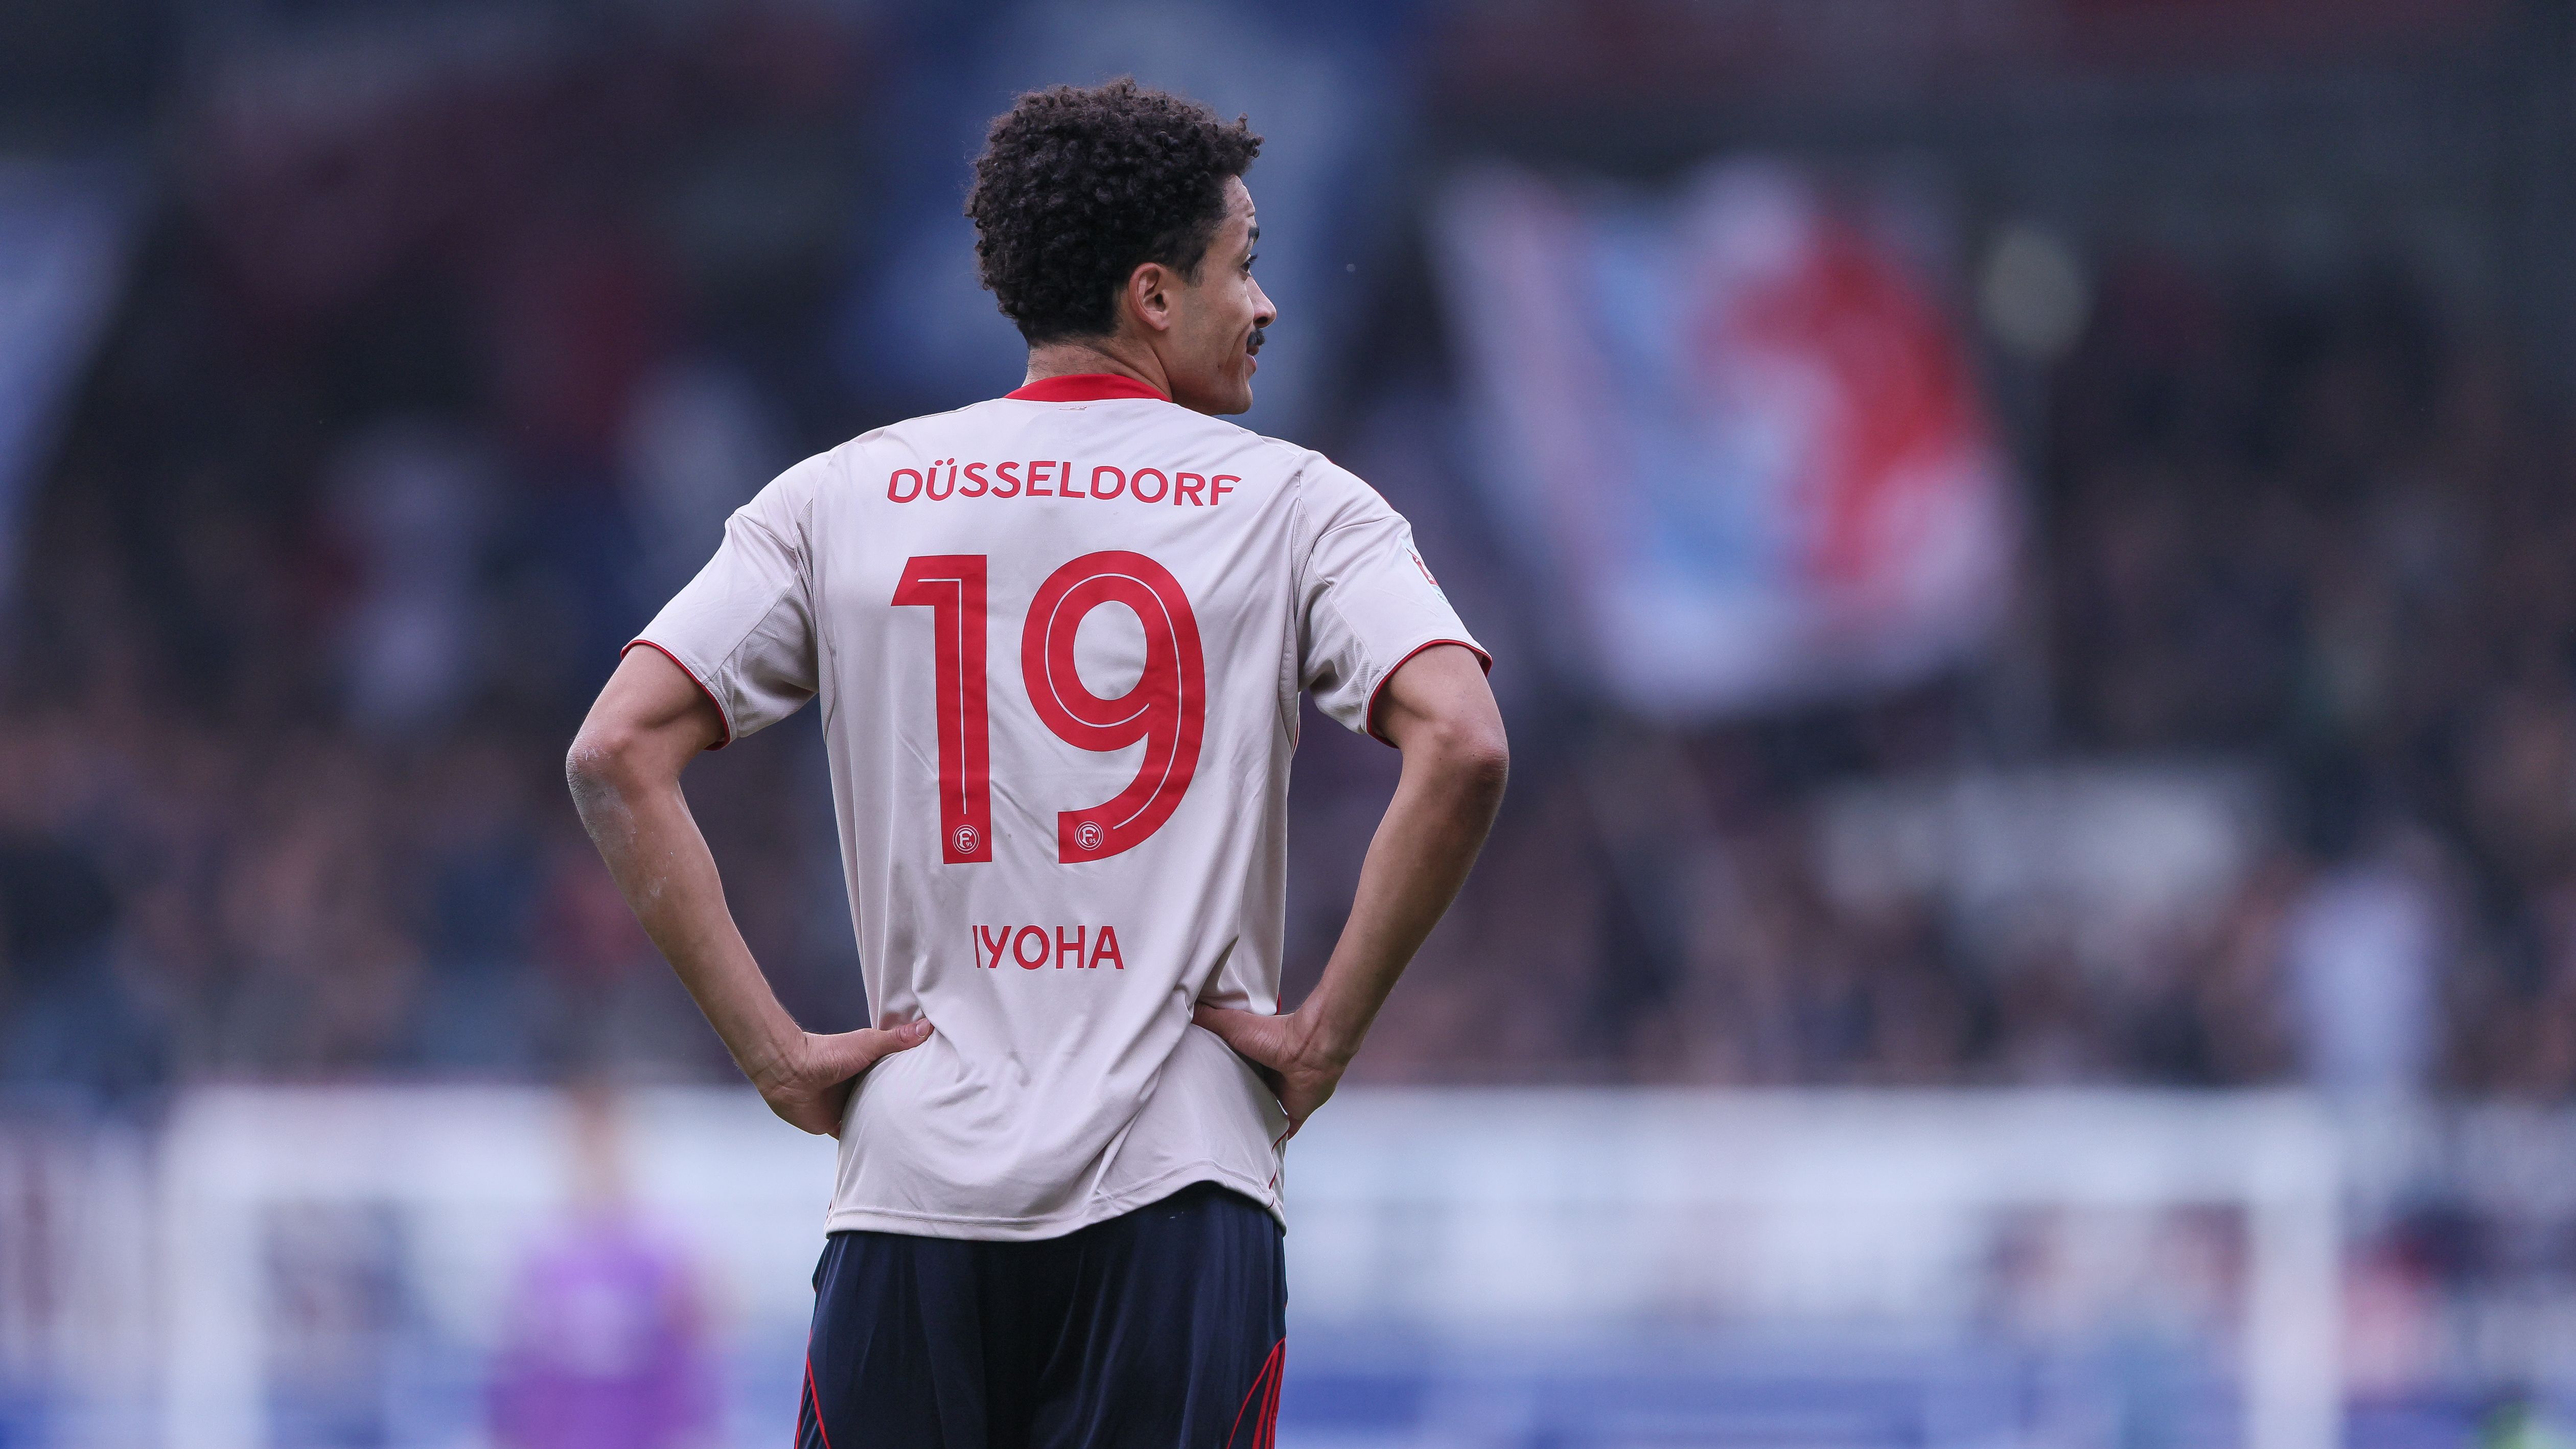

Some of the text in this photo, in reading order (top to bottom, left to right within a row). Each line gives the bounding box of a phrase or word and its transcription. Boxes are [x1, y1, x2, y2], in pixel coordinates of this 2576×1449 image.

[887, 458, 1242, 506] DÜSSELDORF
[891, 550, 1206, 864] 19
[972, 925, 1124, 970] IYOHA
